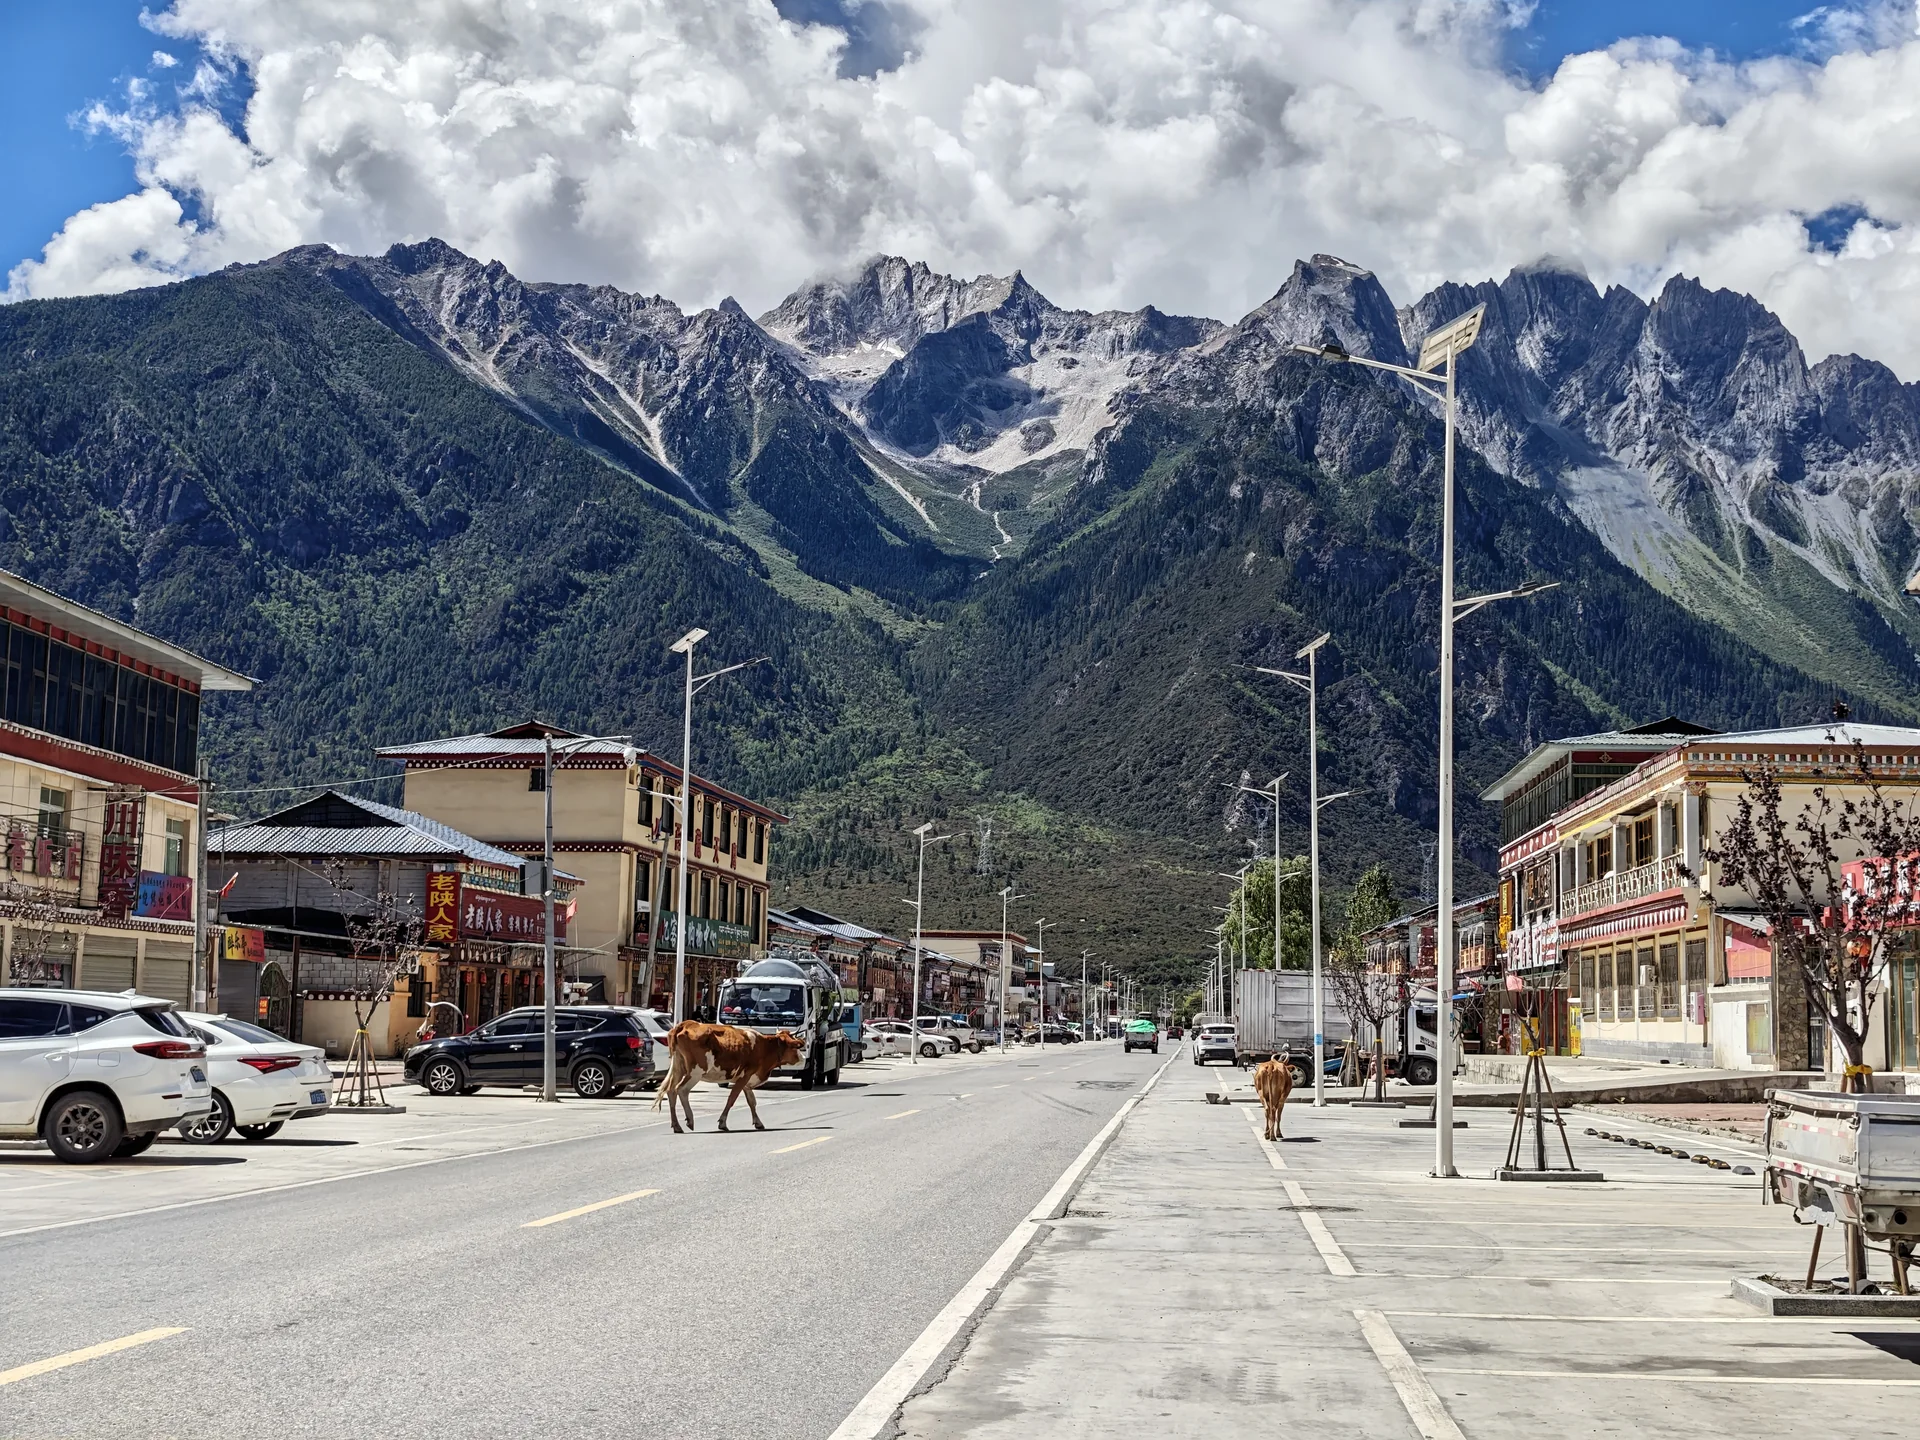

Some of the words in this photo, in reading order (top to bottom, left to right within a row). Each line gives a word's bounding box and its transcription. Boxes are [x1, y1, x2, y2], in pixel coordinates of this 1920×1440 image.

[98, 801, 139, 919] 川味香
[429, 874, 456, 940] 老陕人家
[465, 903, 503, 932] 老陕人家
